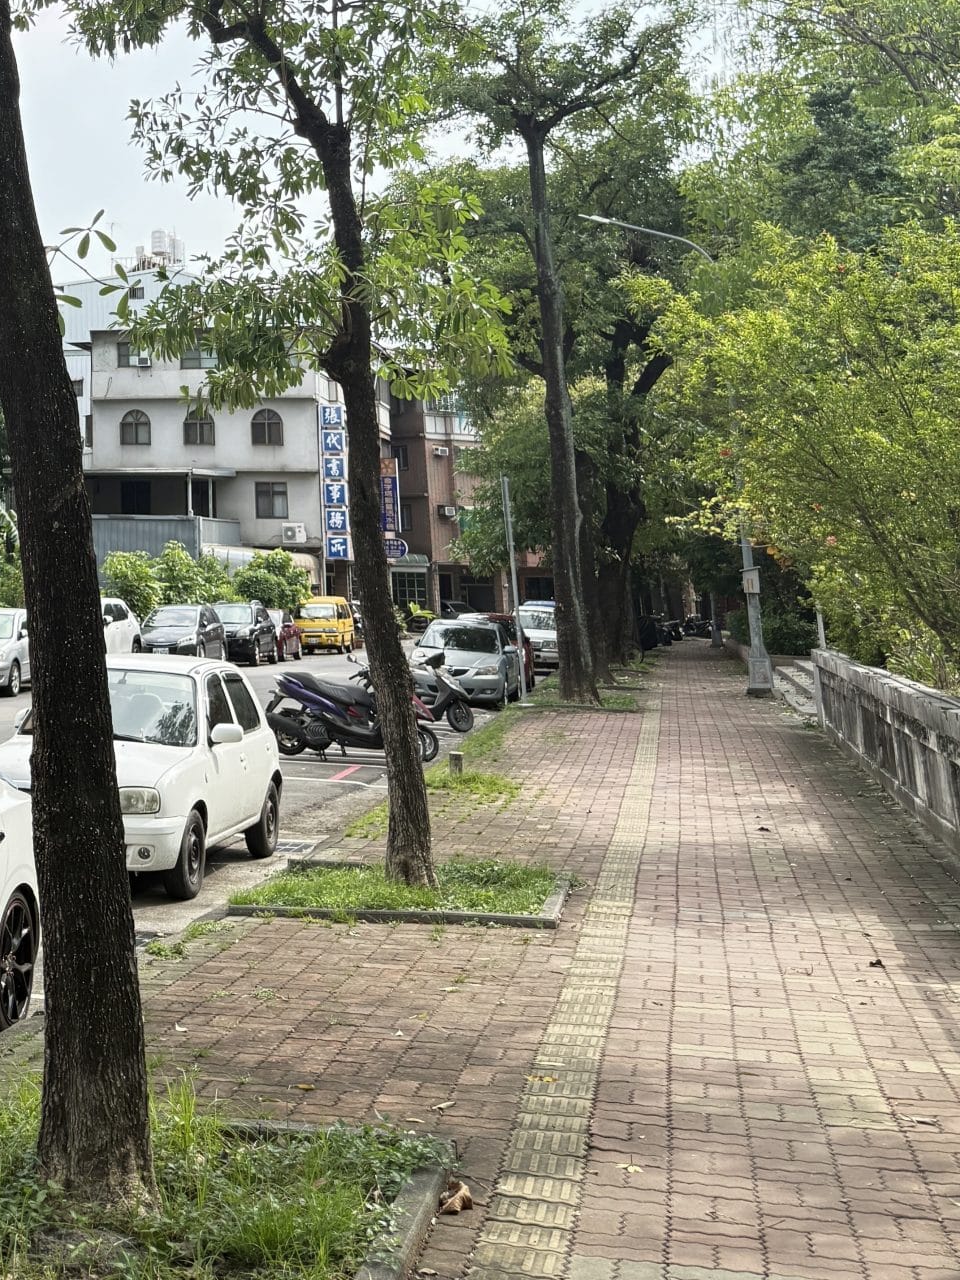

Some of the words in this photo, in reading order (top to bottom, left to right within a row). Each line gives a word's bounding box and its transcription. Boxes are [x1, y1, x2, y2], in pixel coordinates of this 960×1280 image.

[324, 407, 347, 557] 張代書事務所
